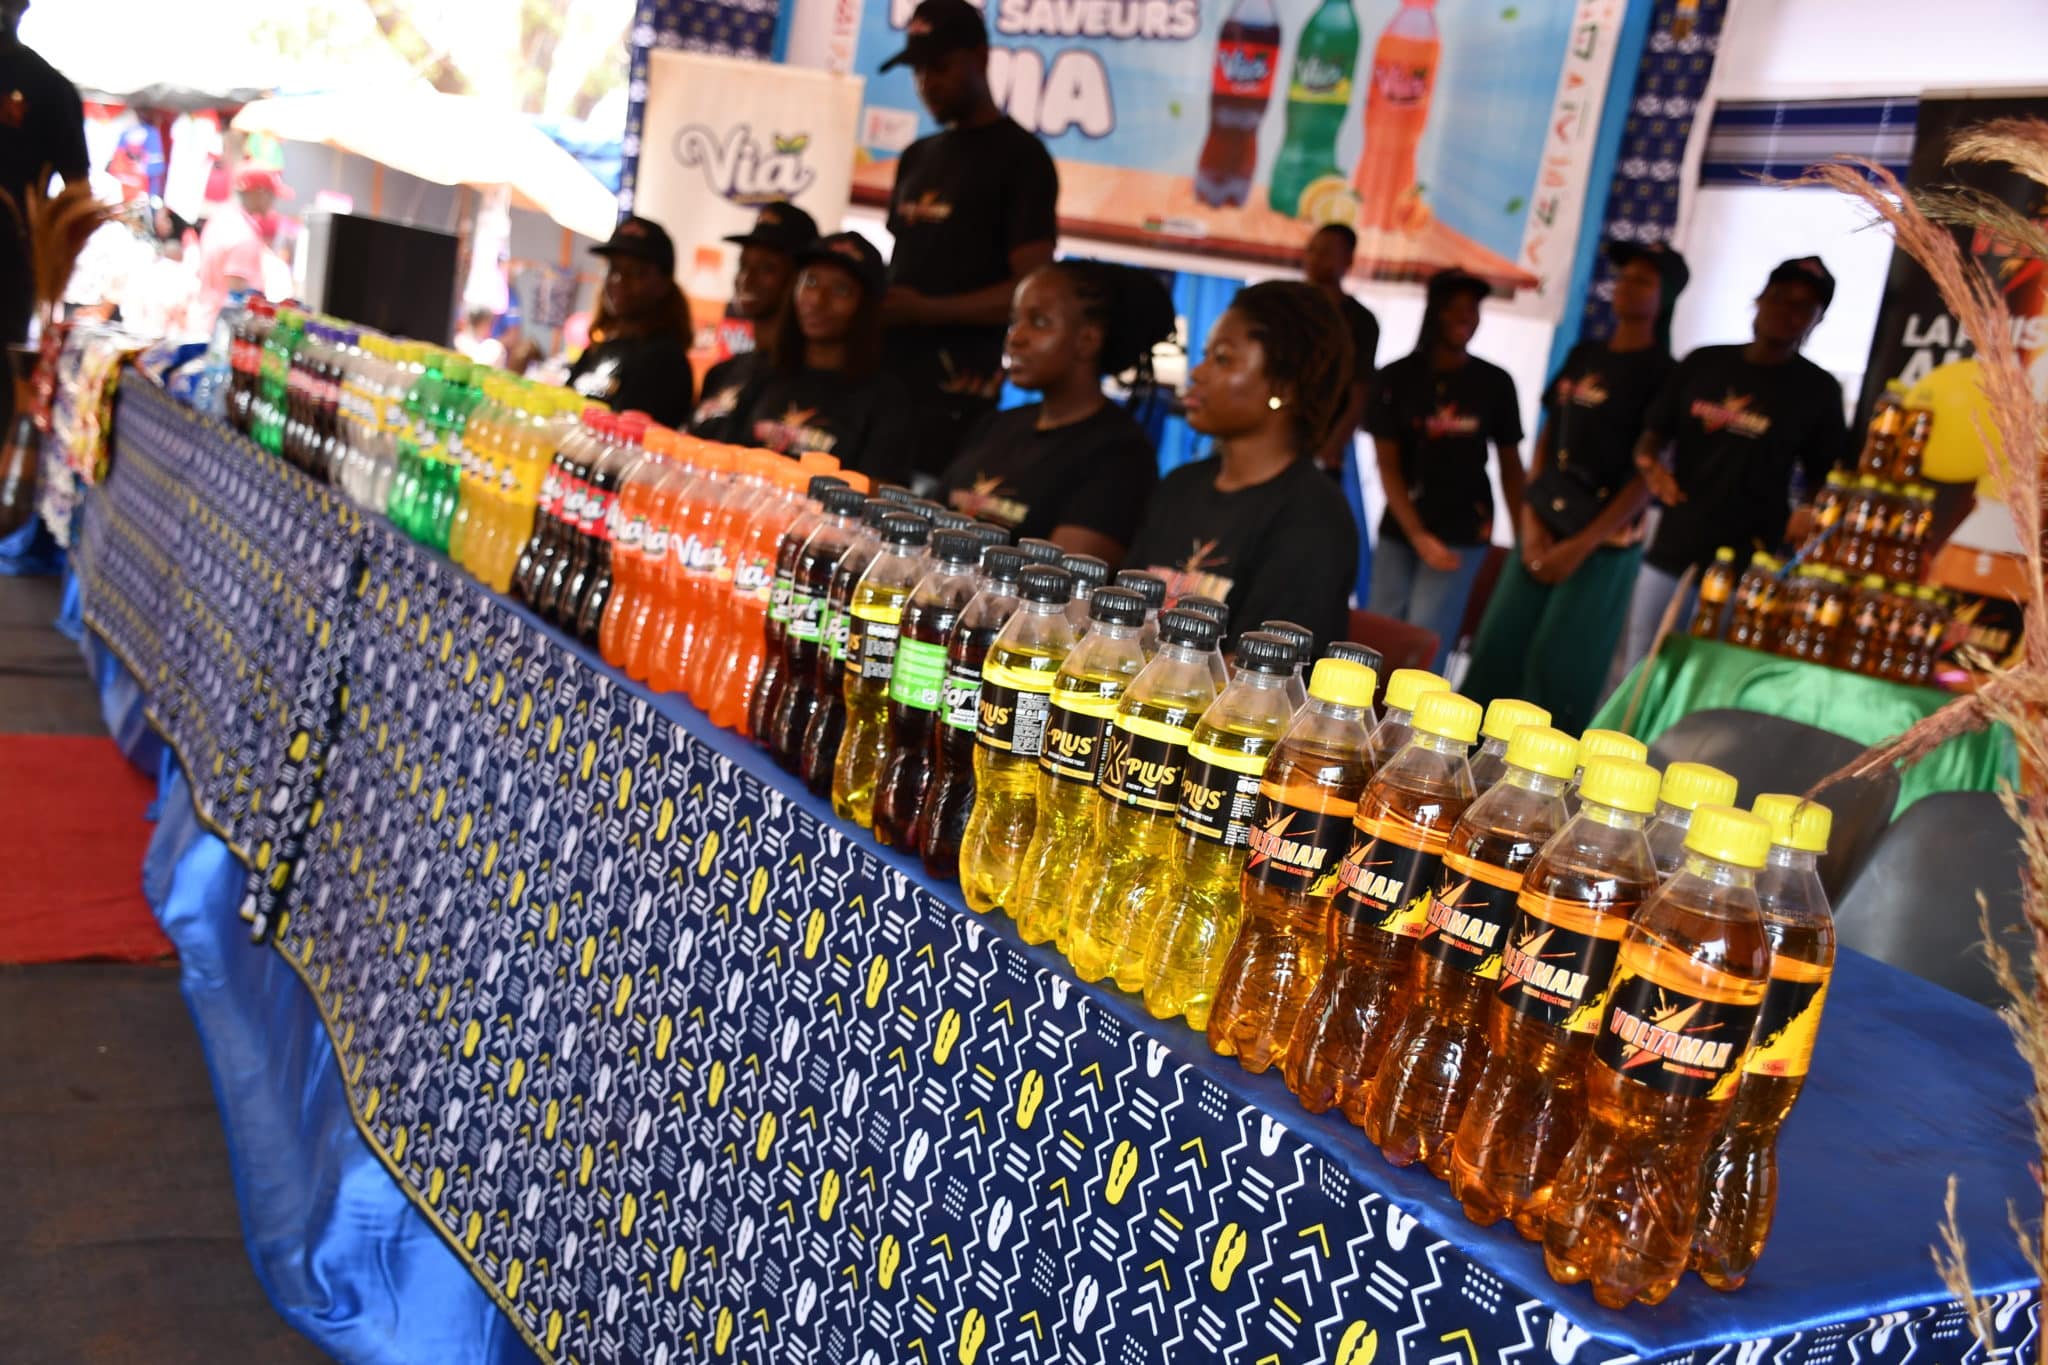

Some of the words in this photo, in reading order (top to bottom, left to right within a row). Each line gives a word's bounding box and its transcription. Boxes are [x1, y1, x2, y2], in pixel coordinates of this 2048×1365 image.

[997, 0, 1199, 38] SAVEURS
[673, 124, 816, 200] Via
[1901, 312, 1951, 349] LA
[671, 532, 727, 568] Via
[1182, 779, 1222, 812] PLUS
[1609, 1006, 1734, 1069] VOLTAMAX
